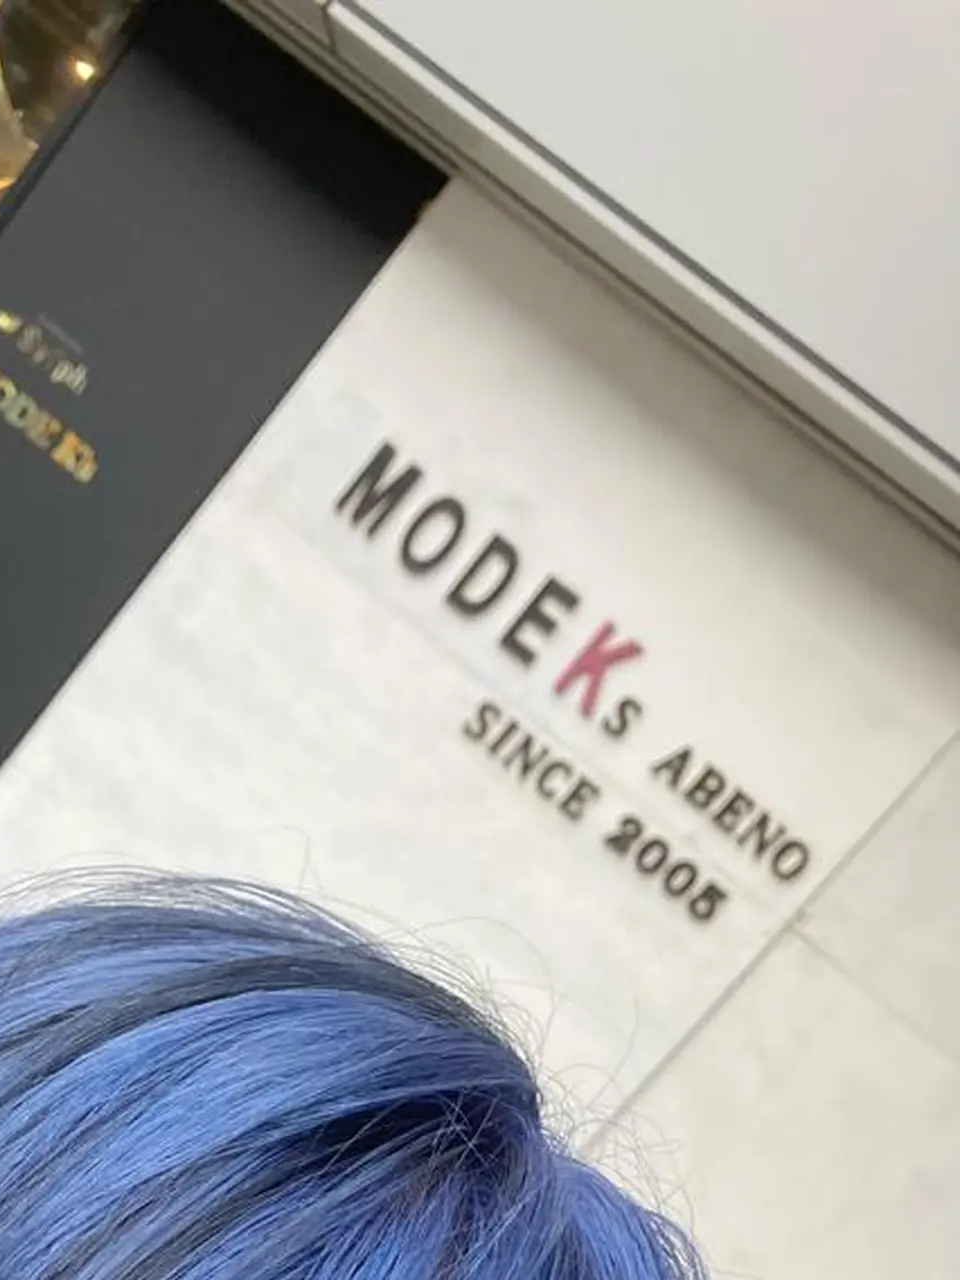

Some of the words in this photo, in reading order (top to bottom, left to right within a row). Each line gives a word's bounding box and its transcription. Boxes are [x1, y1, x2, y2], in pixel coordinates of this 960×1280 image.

[461, 702, 601, 822] SINCE
[603, 815, 730, 922] 2005
[650, 744, 811, 883] ABENO
